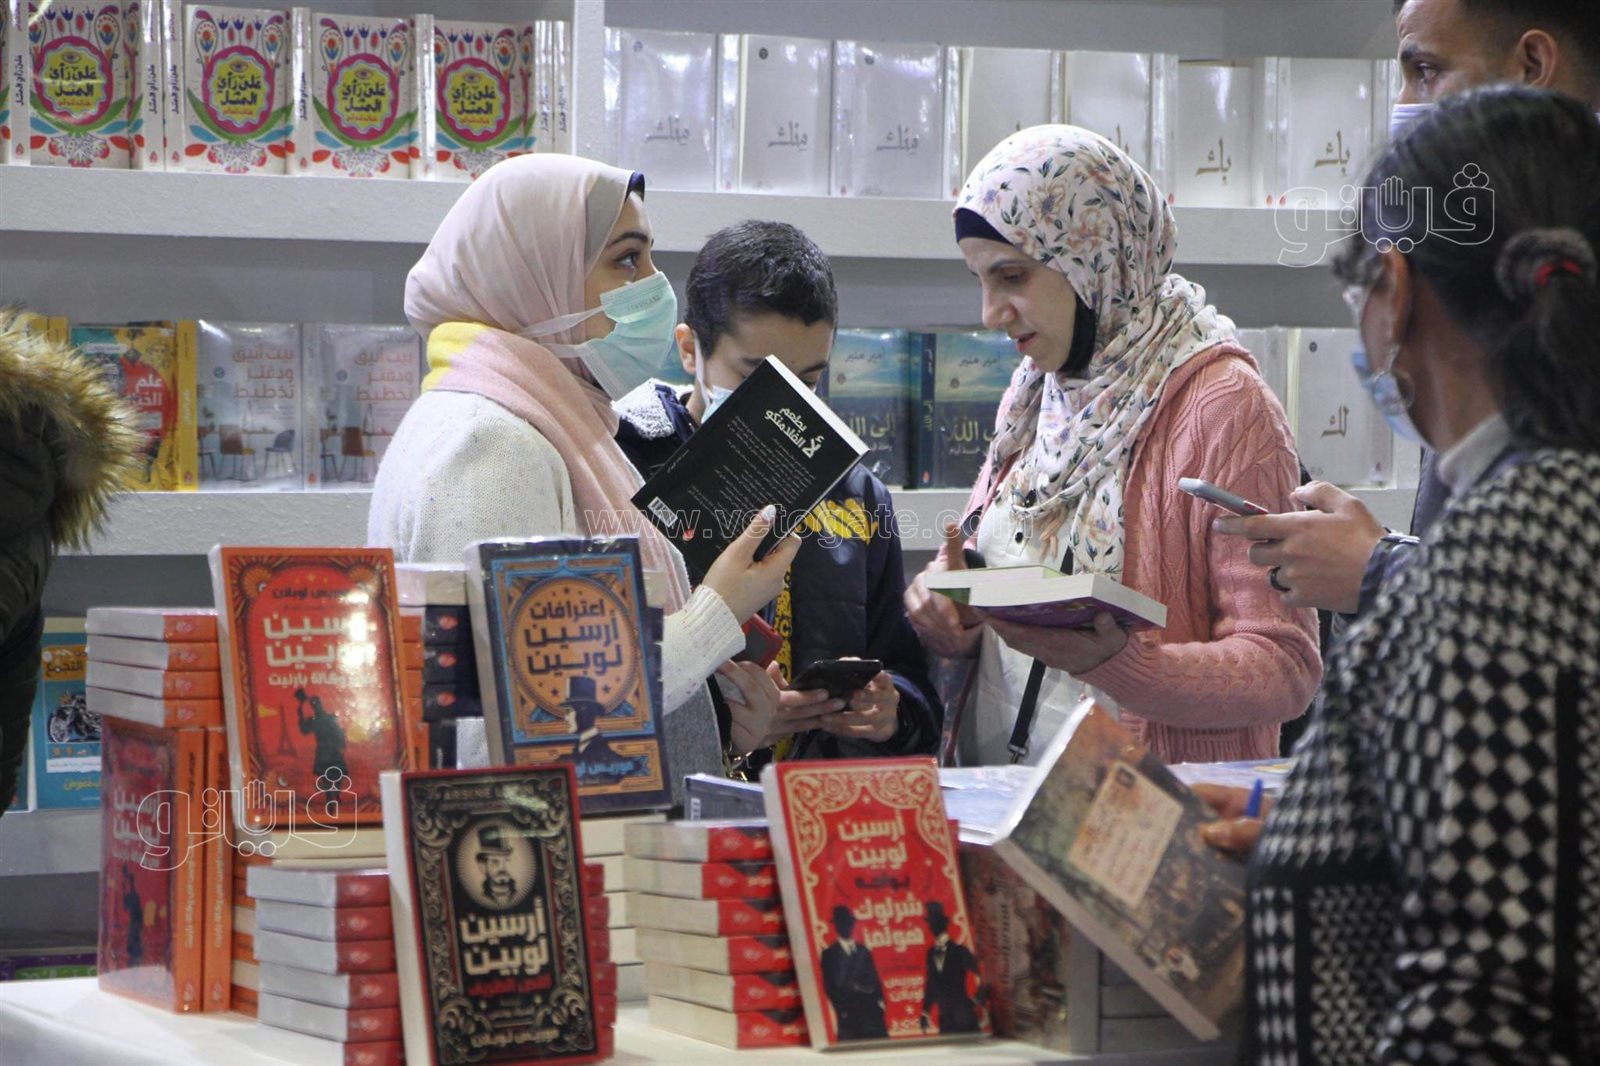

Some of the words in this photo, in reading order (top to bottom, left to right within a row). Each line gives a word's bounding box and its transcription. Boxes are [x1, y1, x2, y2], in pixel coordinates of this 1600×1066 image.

[530, 598, 605, 622] اعترافات
[524, 609, 619, 649] أرسين
[527, 644, 623, 677] لوبين
[838, 809, 906, 843] أرسين
[846, 841, 907, 870] لوبين
[459, 896, 547, 946] أرسين
[463, 936, 549, 976] لوبين
